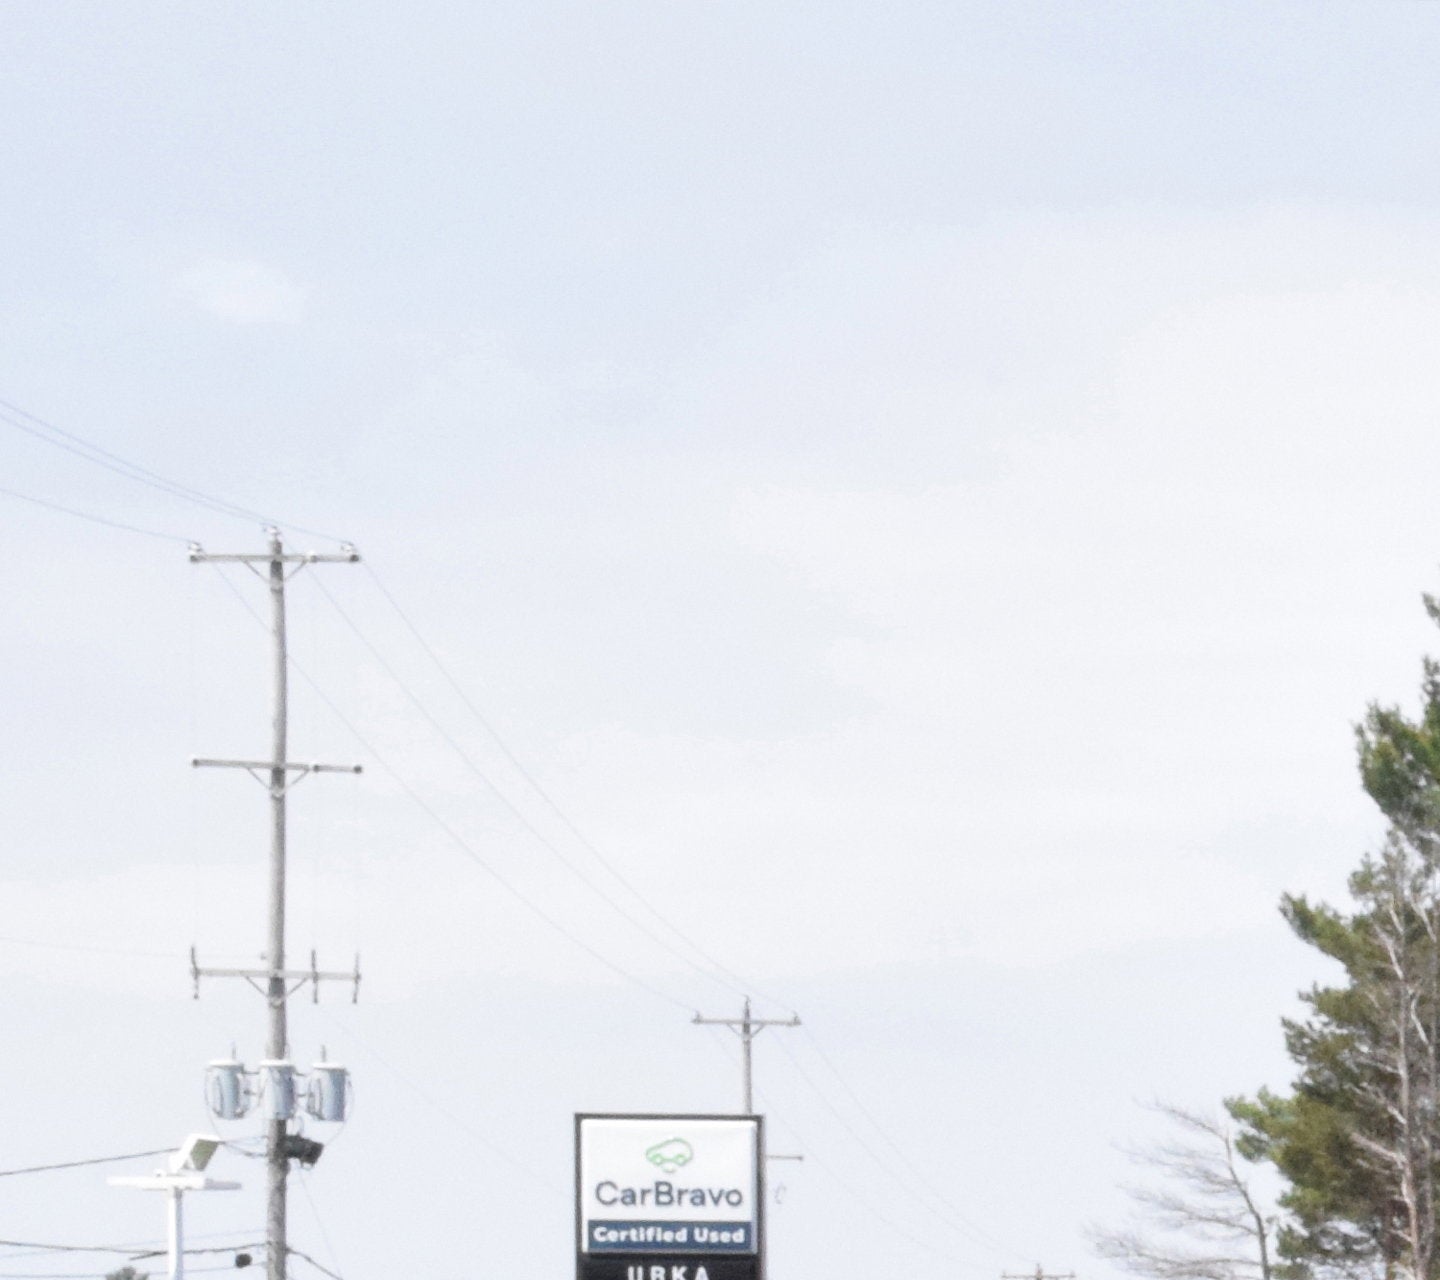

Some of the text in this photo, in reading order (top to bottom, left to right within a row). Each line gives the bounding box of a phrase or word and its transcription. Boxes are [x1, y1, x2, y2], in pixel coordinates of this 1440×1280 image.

[594, 1181, 744, 1206] CarBravo
[593, 1226, 745, 1243] Certified Used
